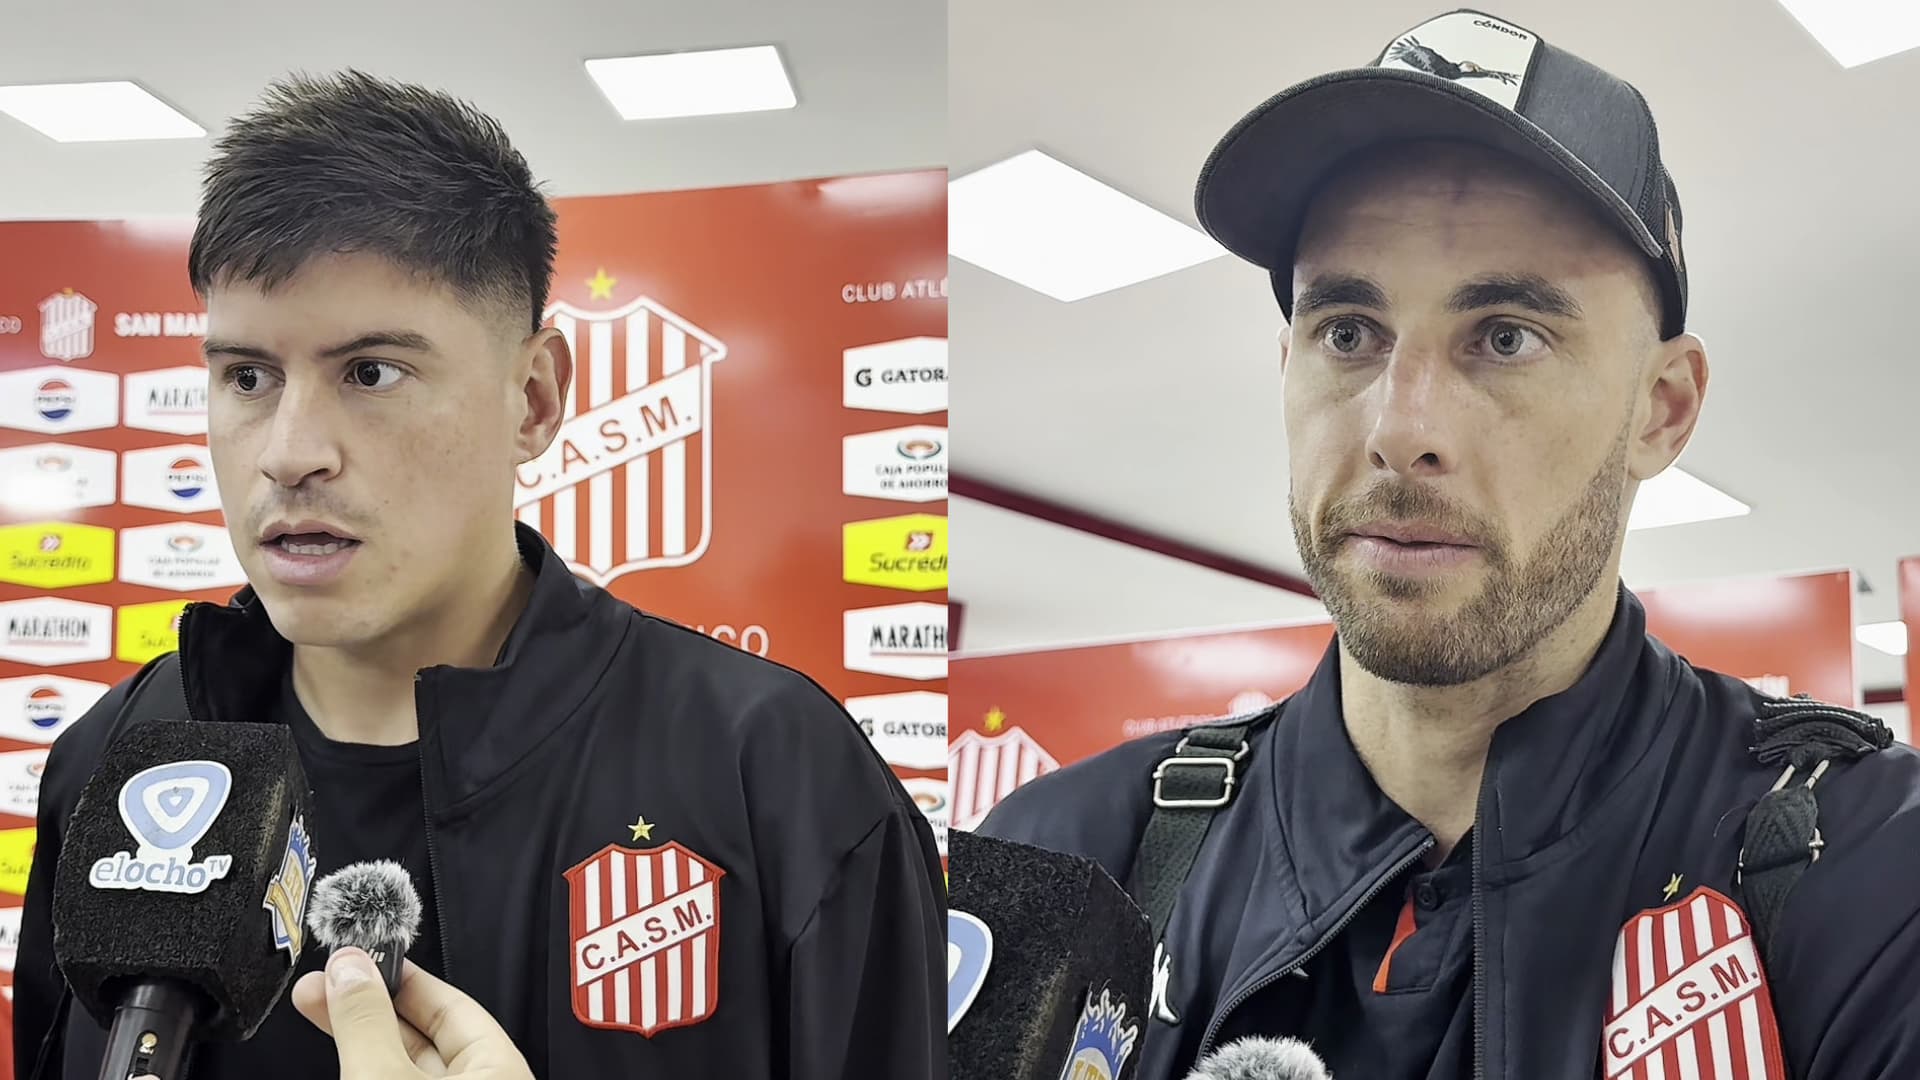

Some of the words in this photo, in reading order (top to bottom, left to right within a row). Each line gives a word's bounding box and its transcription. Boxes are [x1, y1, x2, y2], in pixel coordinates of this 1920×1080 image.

[842, 284, 896, 303] CLUB
[115, 312, 161, 337] SAN
[881, 367, 948, 385] GATOR
[870, 625, 948, 648] MARATH
[581, 899, 712, 970] C.A.S.M.
[1608, 954, 1758, 1059] C.A.S.M.
